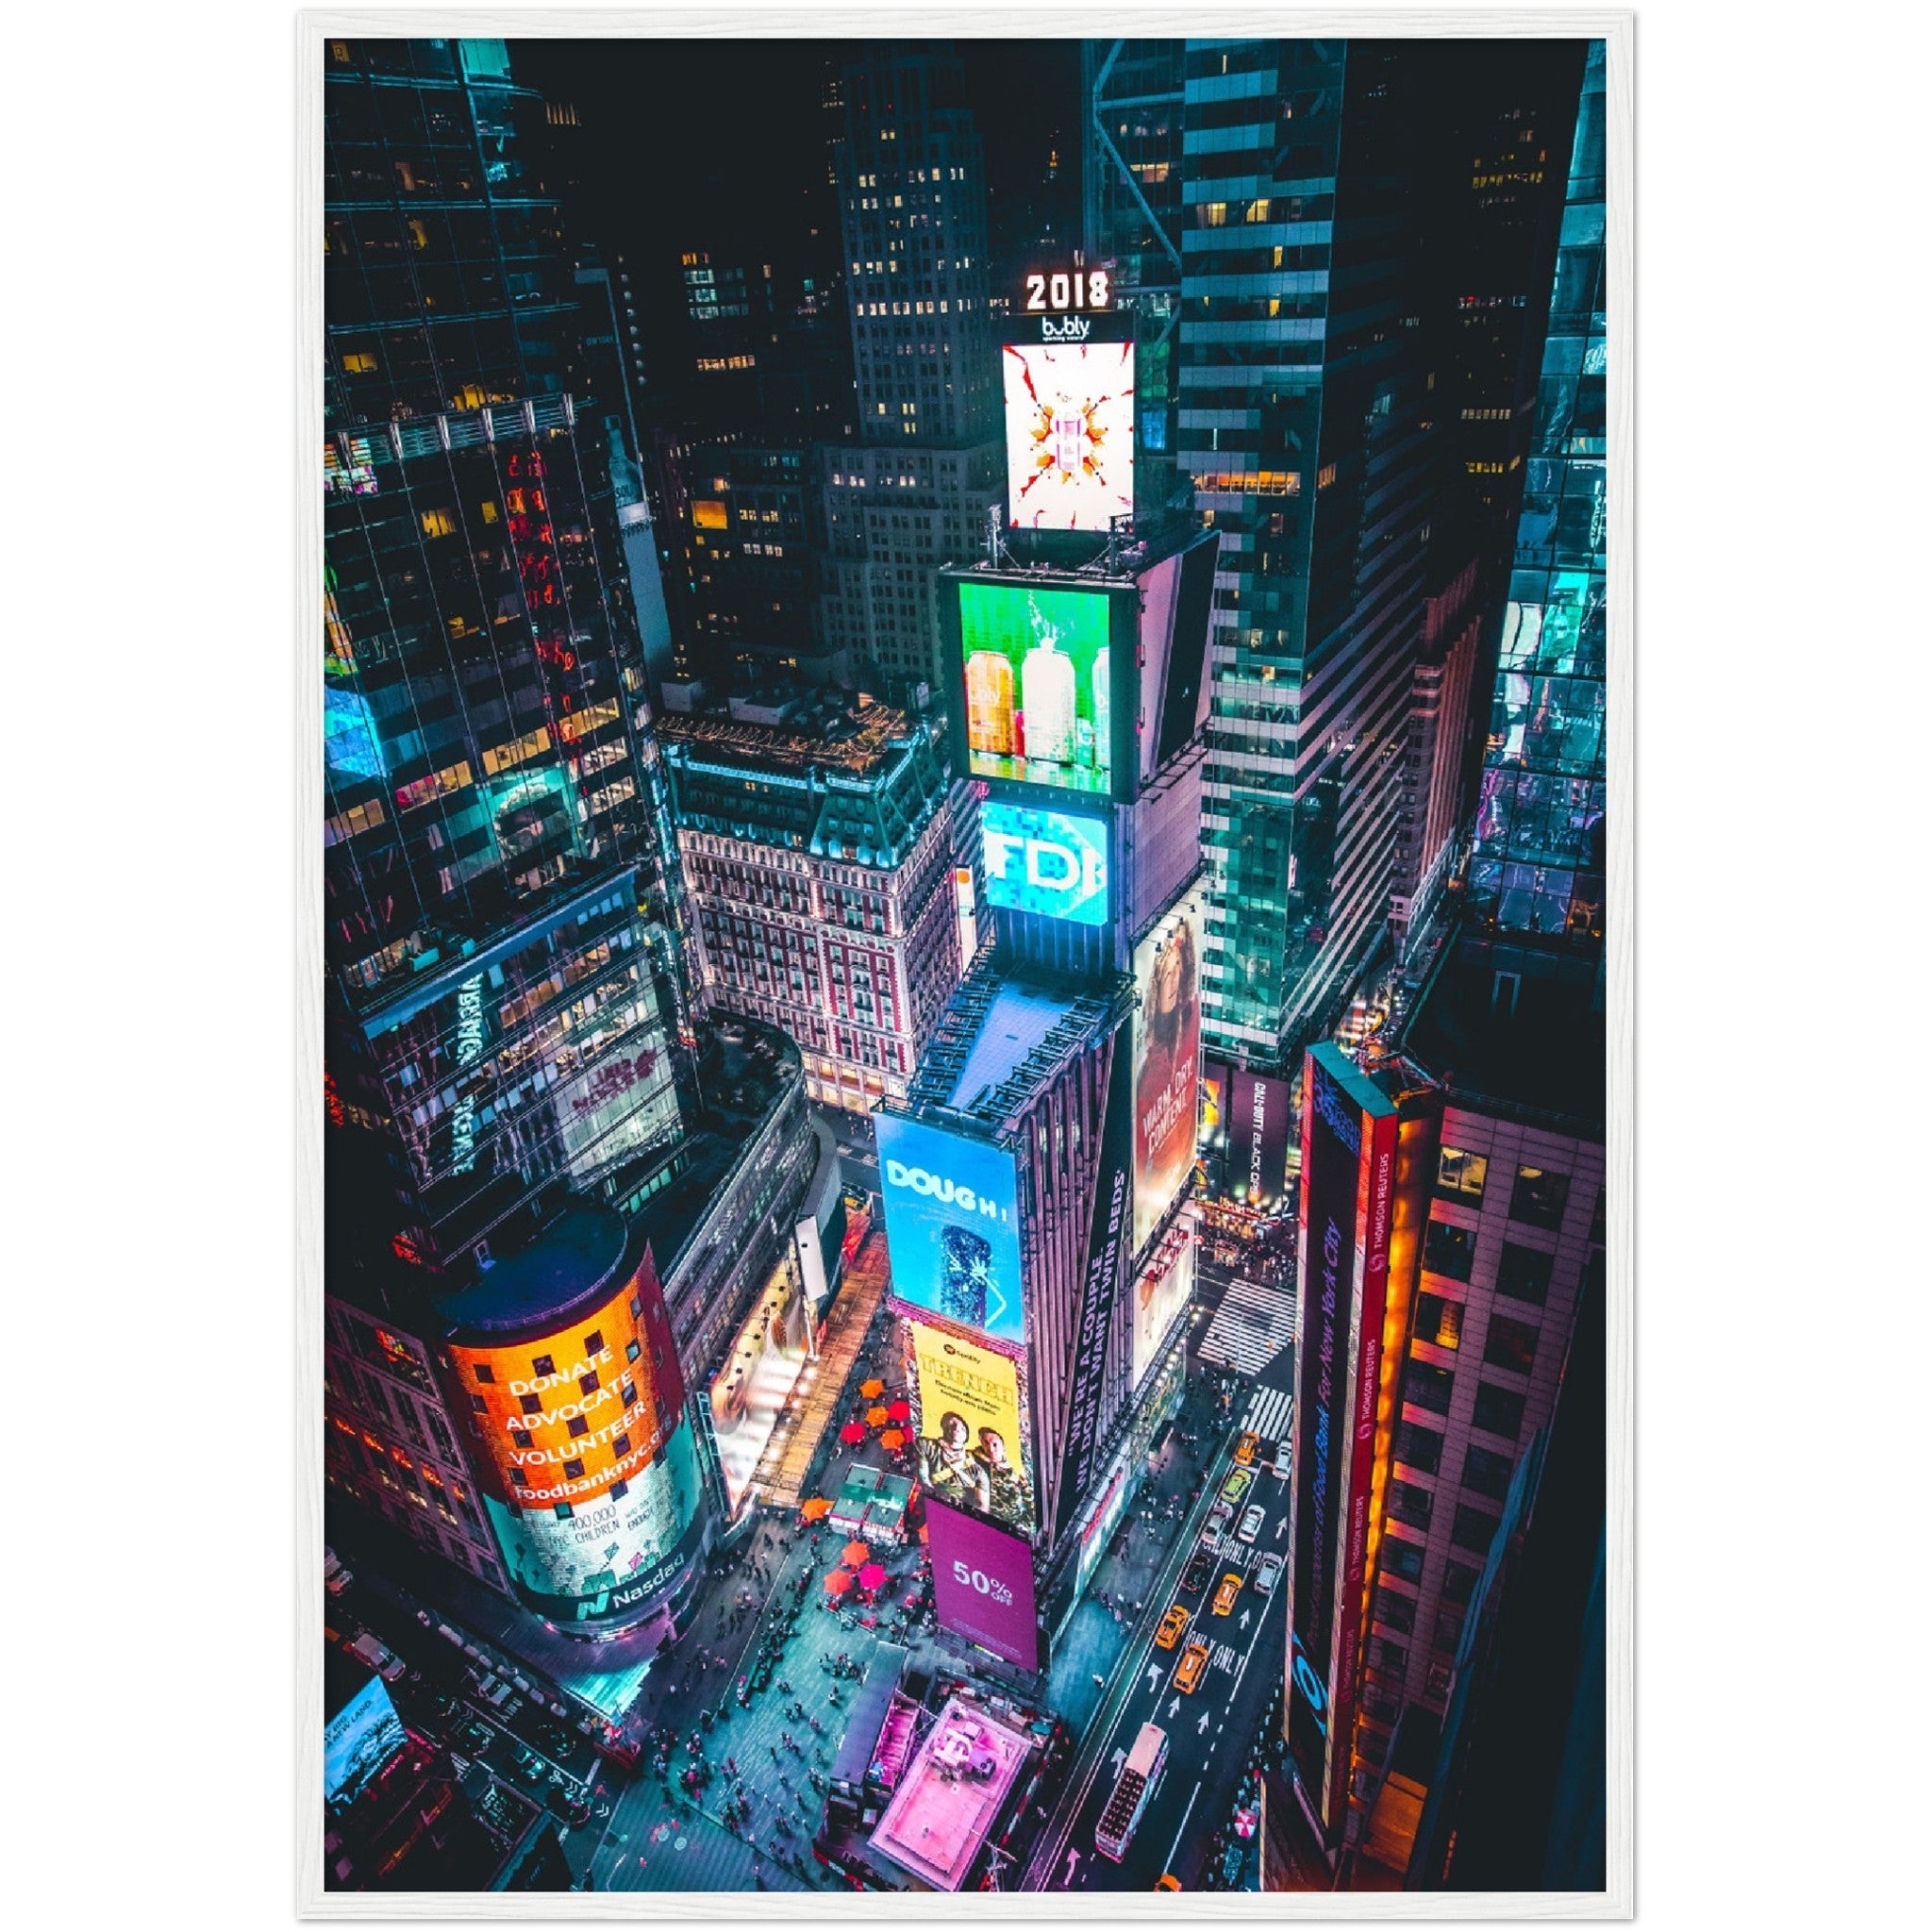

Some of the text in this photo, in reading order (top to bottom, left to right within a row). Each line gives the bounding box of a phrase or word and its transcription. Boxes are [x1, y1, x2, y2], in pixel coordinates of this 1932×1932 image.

[1026, 271, 1108, 309] 2018
[1250, 1132, 1262, 1172] BLACK
[1374, 1153, 1389, 1249] THOMSON REUTERS
[1324, 1215, 1341, 1268] City
[1322, 1266, 1337, 1318] York
[508, 1344, 613, 1397] DONATE
[1075, 1454, 1090, 1493] WE
[1090, 1310, 1108, 1380] WANT
[1099, 1239, 1117, 1305] TWIN
[1080, 1349, 1091, 1366] A
[1319, 1318, 1335, 1374] New
[507, 1368, 634, 1430] ADVOCATE
[1361, 1339, 1376, 1421] THOMSON REUTERS
[509, 1401, 647, 1465] VOLUNTEER
[1314, 1404, 1330, 1459] Bank
[569, 1504, 617, 1532] 400,000
[575, 1520, 620, 1544] CHILDREN
[1355, 1495, 1365, 1529] REUTERS
[953, 1559, 1013, 1599] 50%
[1224, 1539, 1255, 1568] ONLY
[613, 1552, 685, 1608] Nasdaq
[991, 1591, 1013, 1607] OFF
[1213, 1644, 1246, 1677] ONLY
